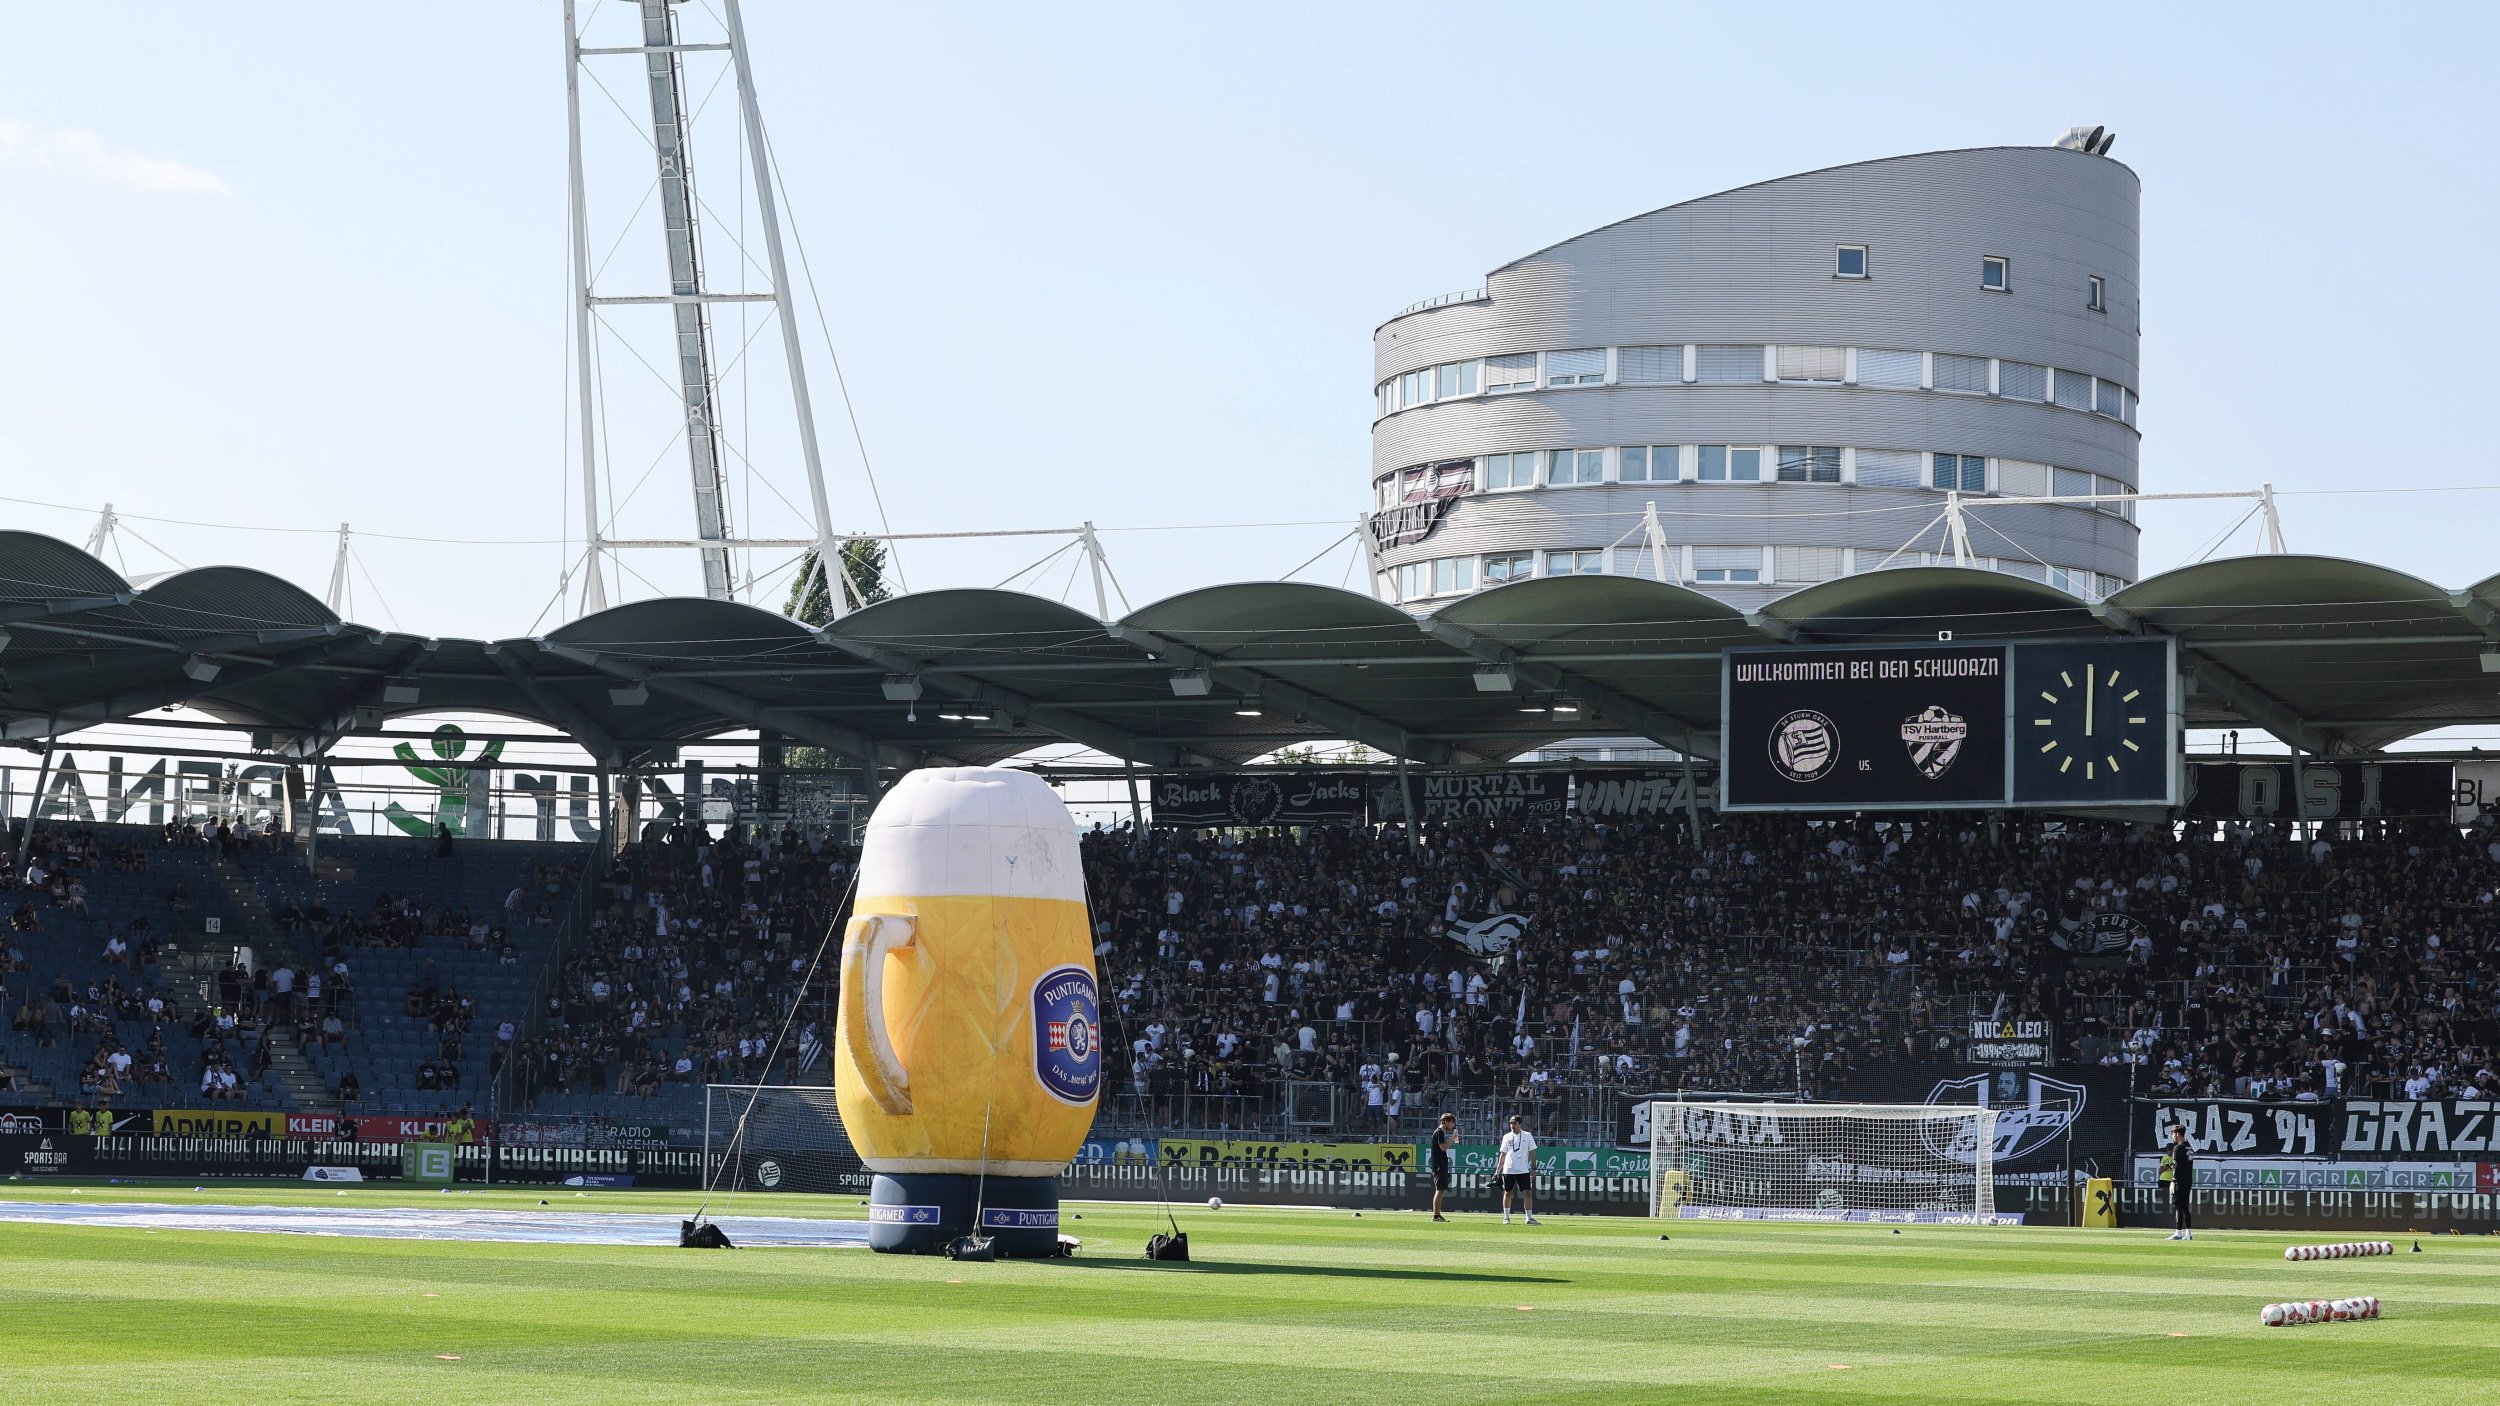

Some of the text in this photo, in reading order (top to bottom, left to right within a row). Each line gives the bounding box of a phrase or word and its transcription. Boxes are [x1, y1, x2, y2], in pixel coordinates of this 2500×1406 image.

[1737, 657, 1999, 681] WILLKOMMEN BEI DEN SCHWOAZN
[1790, 712, 1811, 721] STURM
[1812, 714, 1829, 727] GRAZ
[1903, 725, 1966, 736] TSV Hartberg
[1157, 779, 1360, 807] Black Jacks
[1423, 774, 1546, 798] MURTAL
[1423, 797, 1562, 821] FRONT 2009
[1044, 981, 1097, 1011] PUNTIGAMER
[1052, 1064, 1068, 1082] DAS
[158, 1114, 269, 1138] ADMIRAL
[609, 1126, 651, 1138] RADIO
[2155, 1104, 2257, 1153] GRAZ
[24, 1152, 52, 1164] SPORTS
[1199, 1143, 1372, 1171] Raiffeisen
